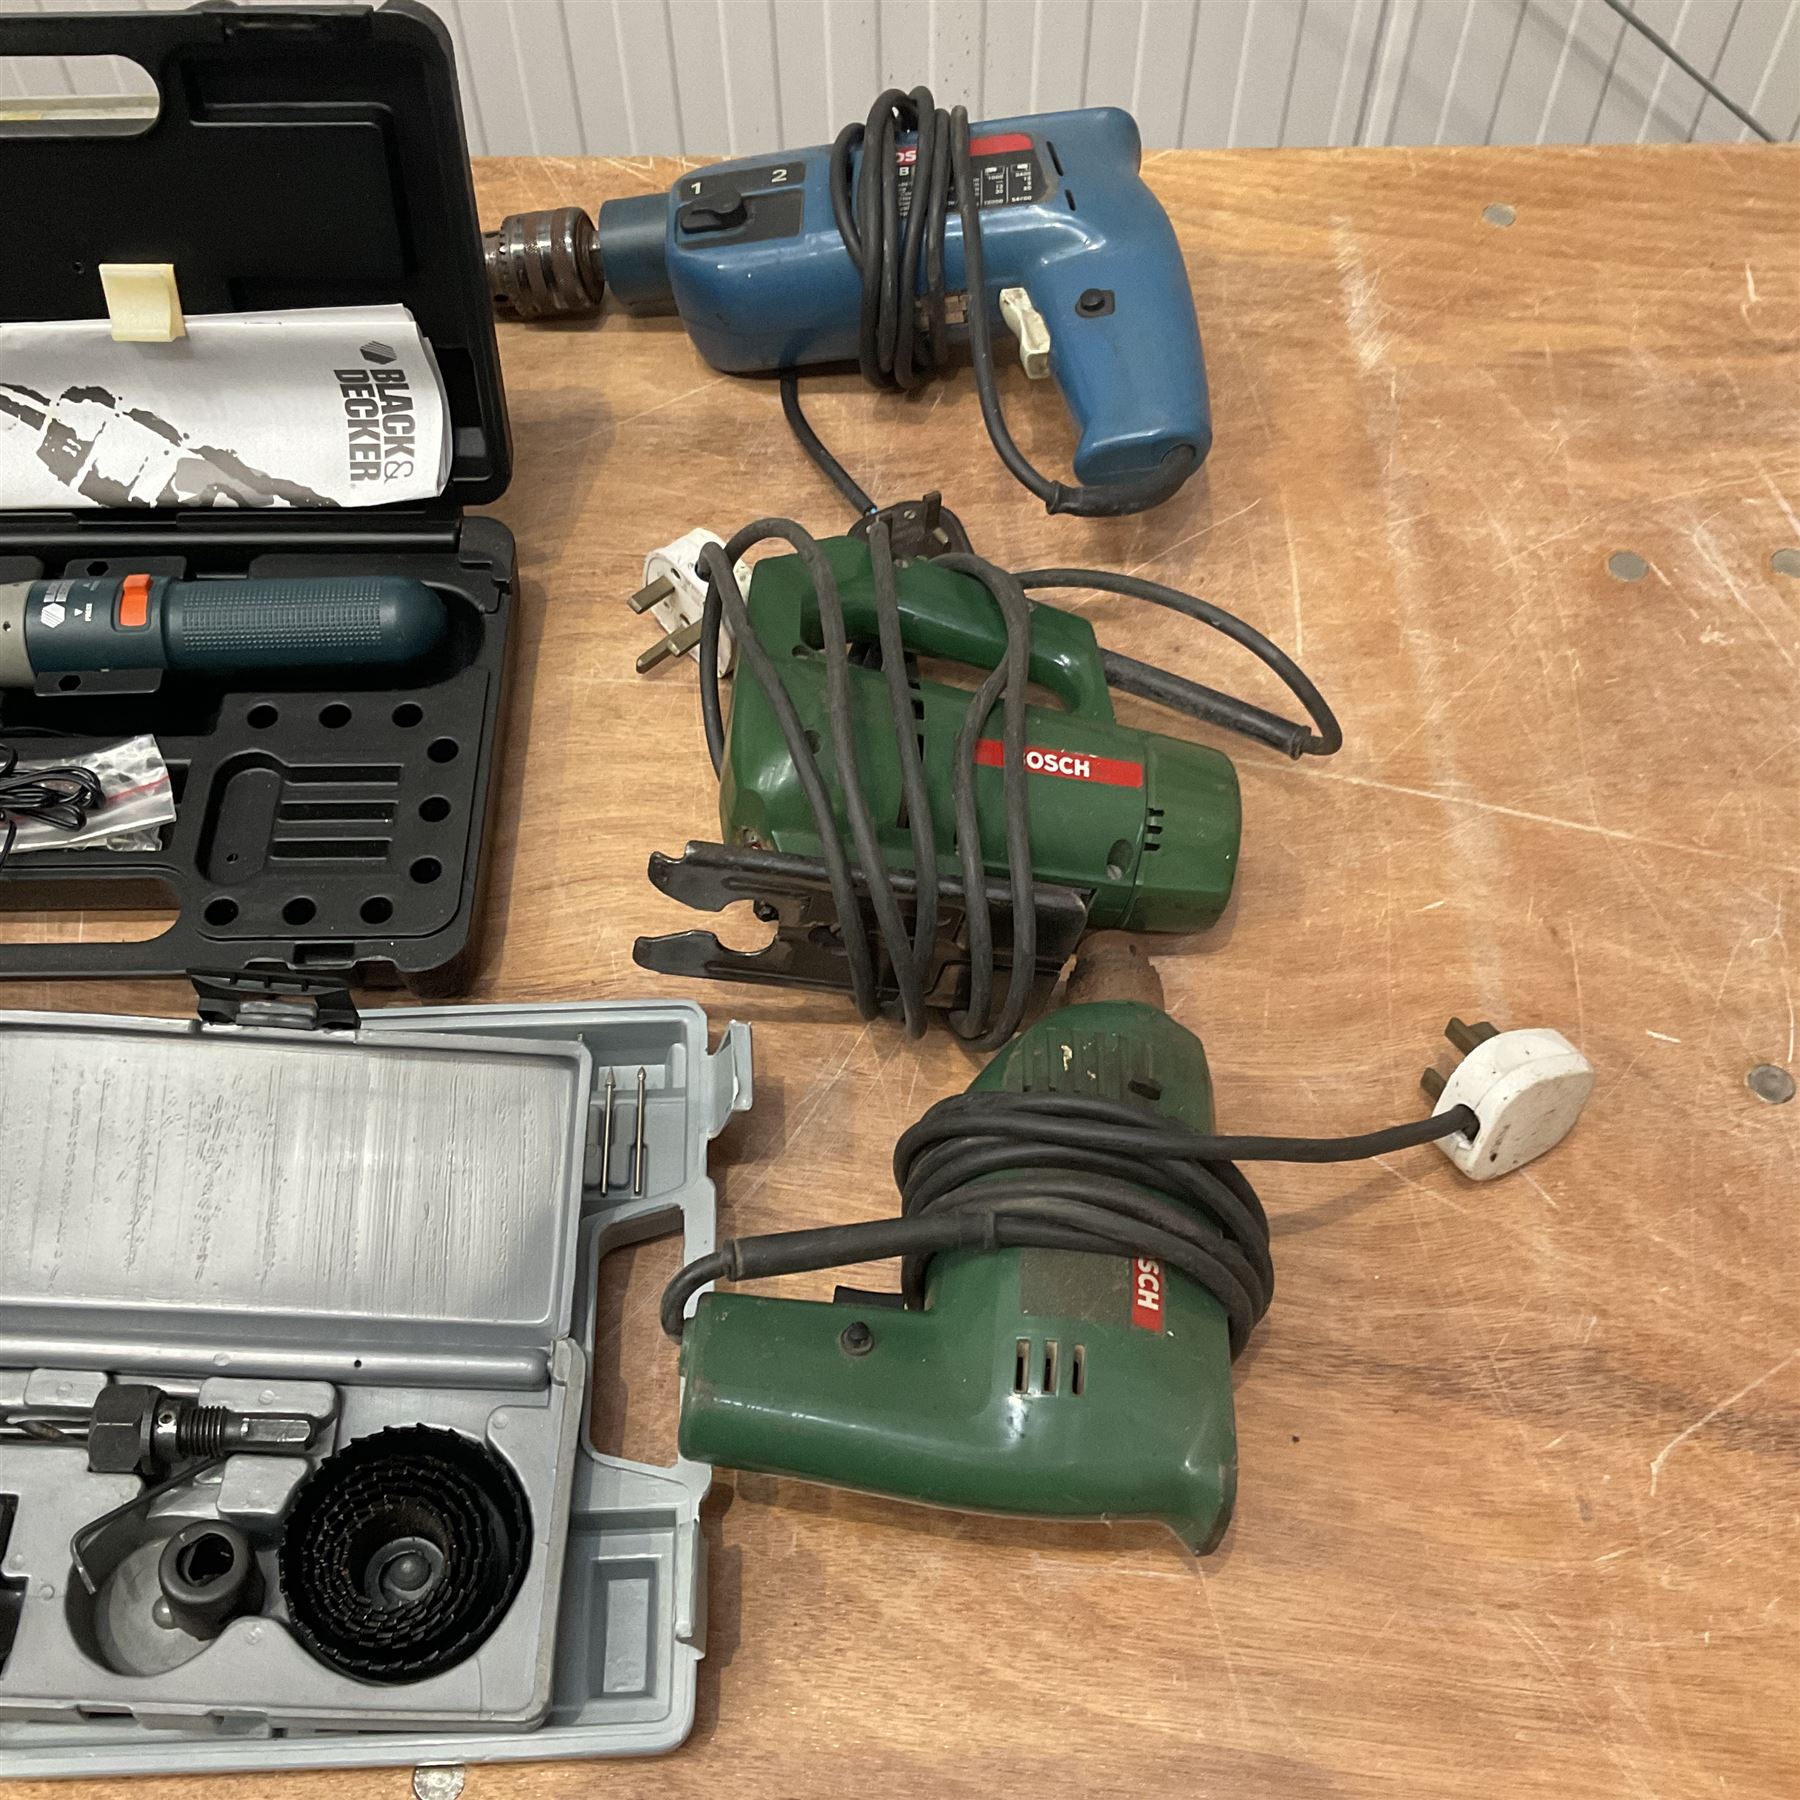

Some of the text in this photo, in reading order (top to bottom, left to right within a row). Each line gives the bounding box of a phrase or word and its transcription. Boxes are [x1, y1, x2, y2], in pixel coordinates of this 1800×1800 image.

[691, 182, 702, 195] 1
[771, 169, 788, 183] 2
[333, 369, 382, 482] DECKER
[1023, 751, 1090, 778] OSCH
[1137, 1256, 1160, 1311] SCH
